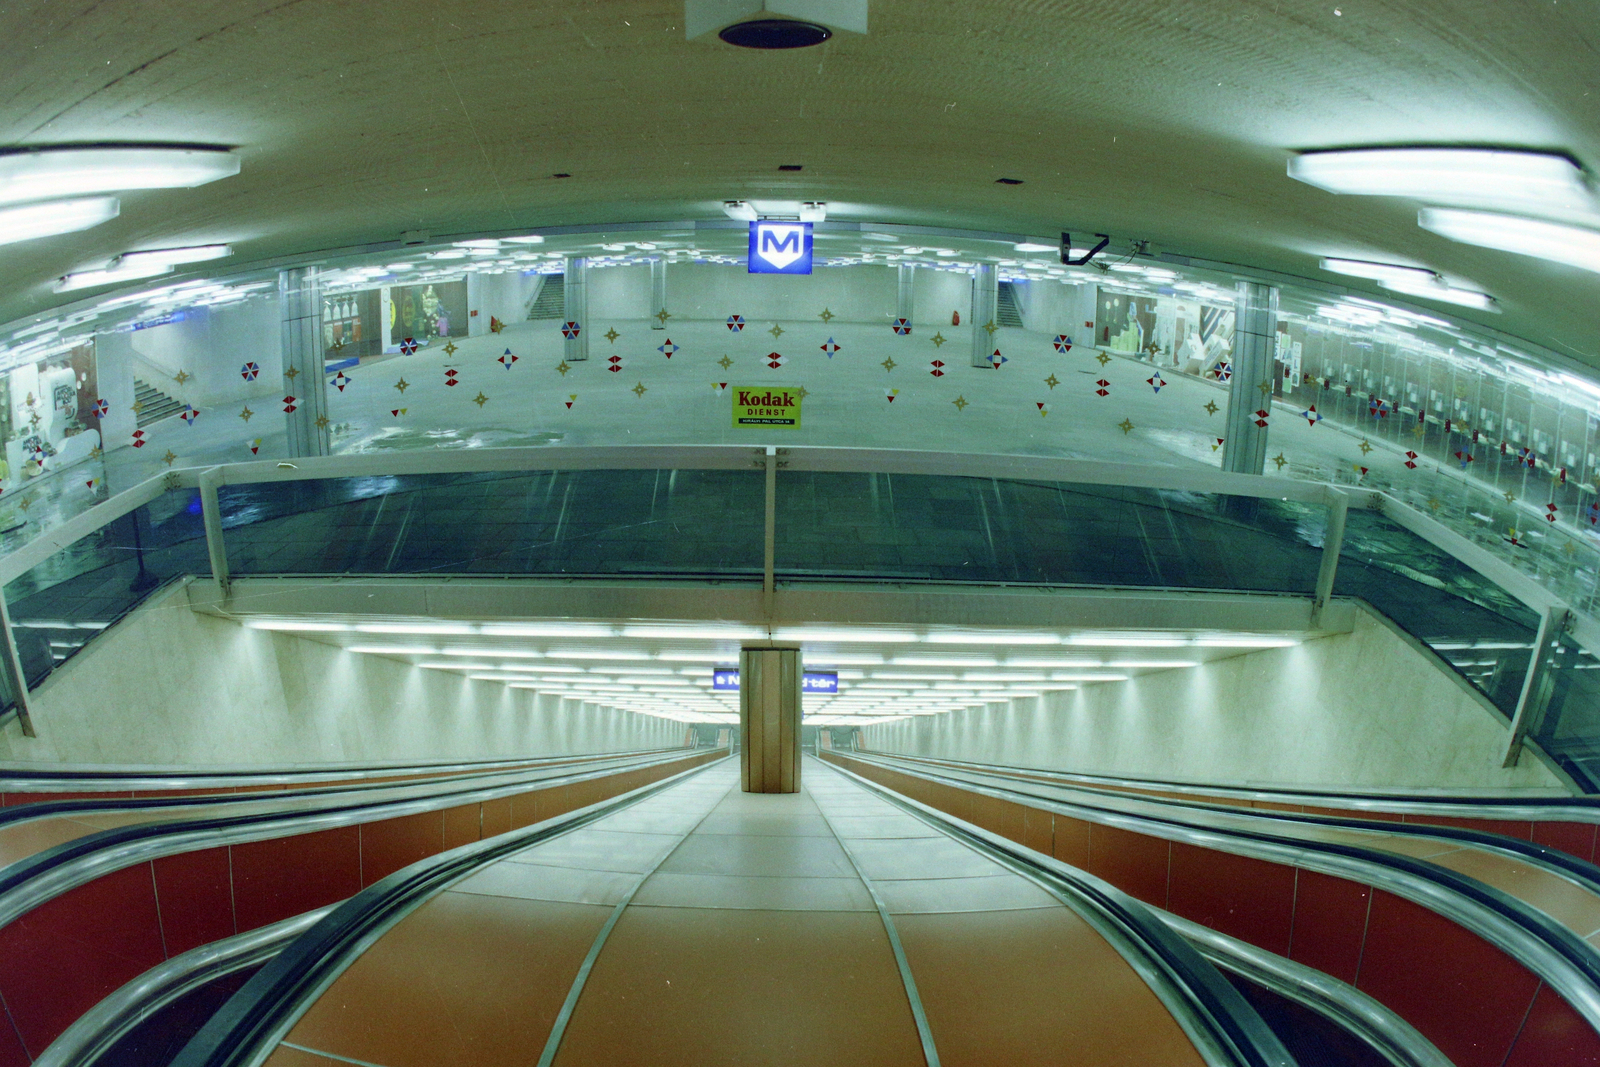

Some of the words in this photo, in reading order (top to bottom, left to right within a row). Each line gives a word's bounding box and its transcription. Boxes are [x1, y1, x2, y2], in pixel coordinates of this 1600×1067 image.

[762, 230, 799, 253] M
[739, 391, 795, 407] Kodak
[747, 408, 786, 416] DIENST
